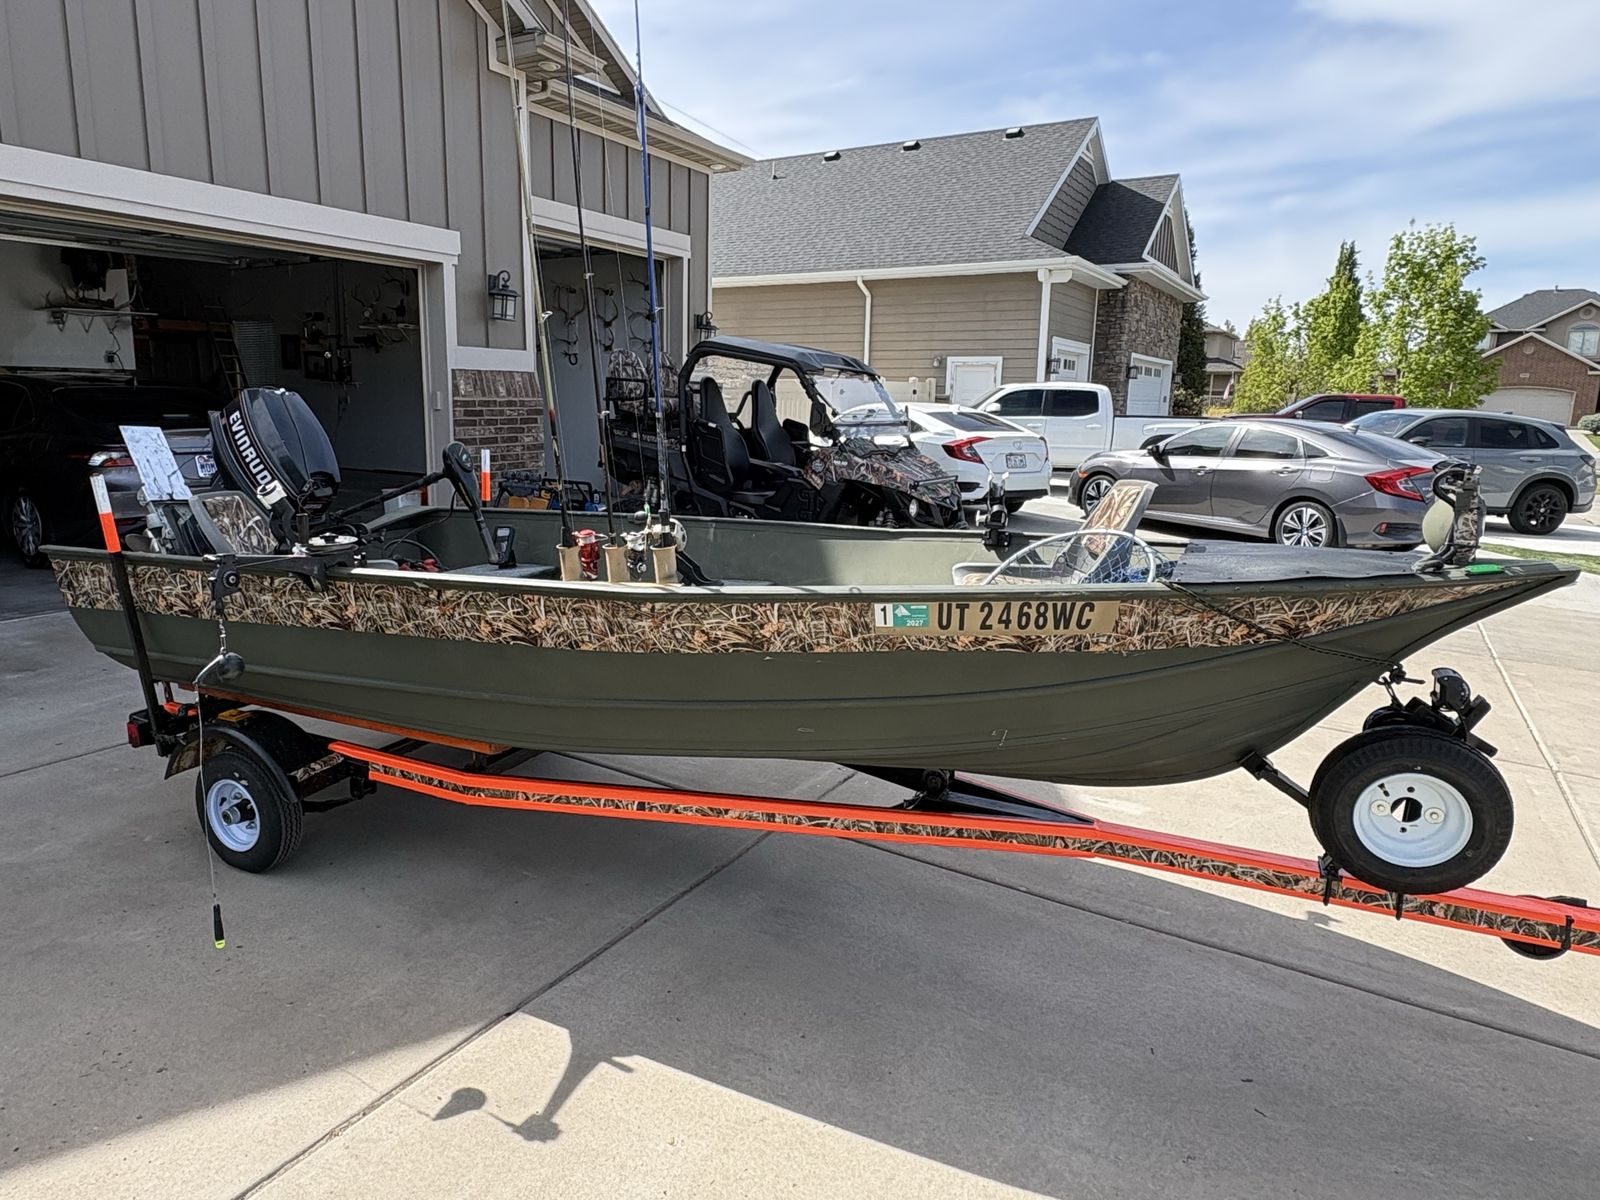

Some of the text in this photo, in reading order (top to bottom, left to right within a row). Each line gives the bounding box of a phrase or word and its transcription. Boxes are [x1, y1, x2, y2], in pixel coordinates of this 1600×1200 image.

[229, 410, 275, 488] EVINRUD
[880, 604, 888, 626] 1
[906, 619, 924, 627] 2027
[937, 601, 1096, 631] UT 2468WC
